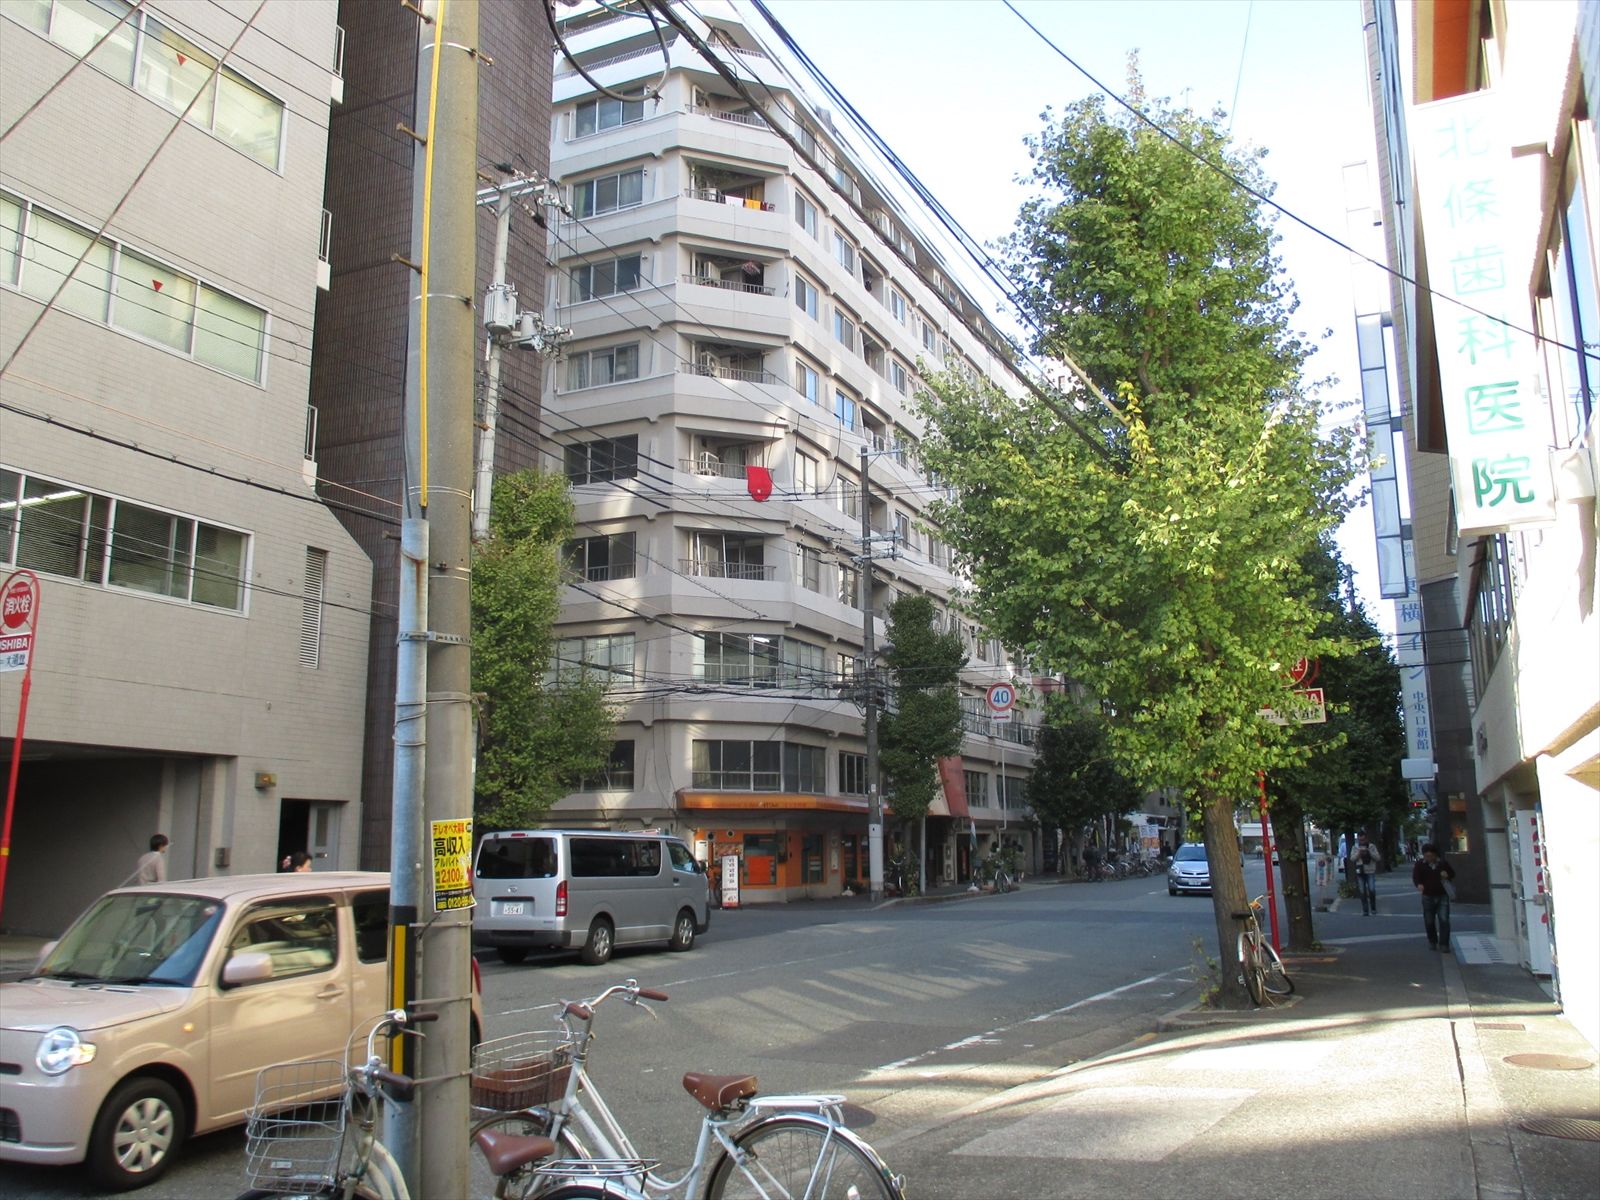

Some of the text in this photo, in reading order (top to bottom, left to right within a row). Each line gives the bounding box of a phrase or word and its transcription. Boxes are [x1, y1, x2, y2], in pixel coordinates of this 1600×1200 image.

[1437, 114, 1536, 509] 北條歯科医院
[5, 595, 32, 615] 消火栓
[0, 638, 28, 651] SHIBA
[993, 691, 1009, 704] 40
[1412, 690, 1429, 751] 中央口新館
[433, 836, 466, 857] 高収入
[434, 857, 459, 868] アルバイト
